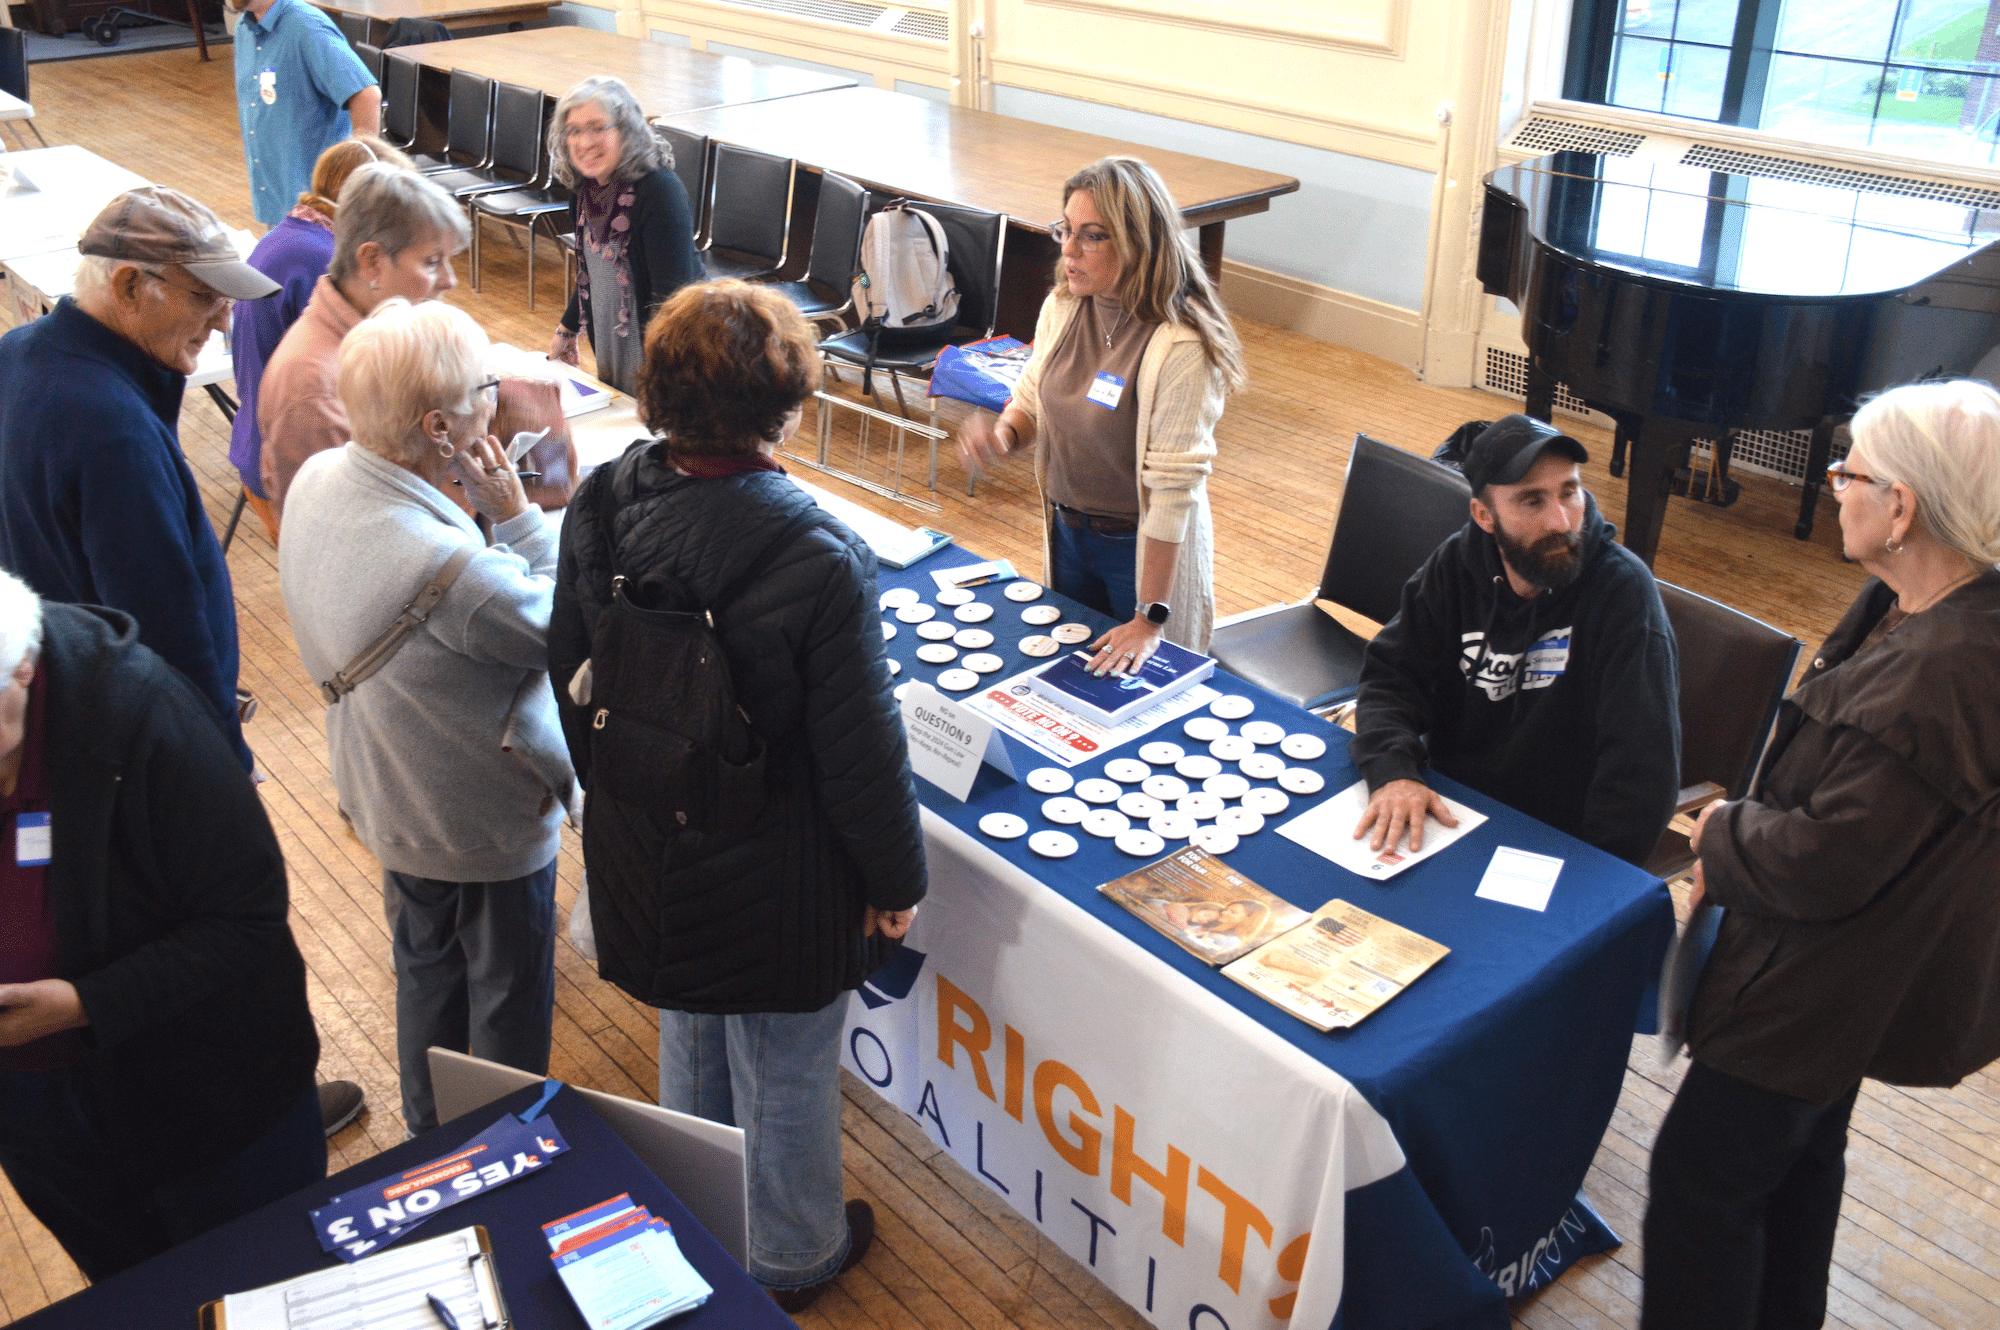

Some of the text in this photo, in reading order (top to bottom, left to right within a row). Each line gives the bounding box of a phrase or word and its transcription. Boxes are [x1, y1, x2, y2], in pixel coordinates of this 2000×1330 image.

[915, 706, 972, 745] QUESTION 9
[1010, 701, 1042, 721] VOTE
[1034, 716, 1058, 729] NO
[1051, 724, 1073, 738] ON
[1068, 732, 1081, 741] 9
[1177, 855, 1193, 866] FOR
[1190, 863, 1208, 875] OUR
[1185, 850, 1202, 862] FOR
[1225, 875, 1244, 886] FOR
[452, 1151, 542, 1197] YES
[368, 1188, 441, 1230] ON
[327, 1216, 360, 1243] 3
